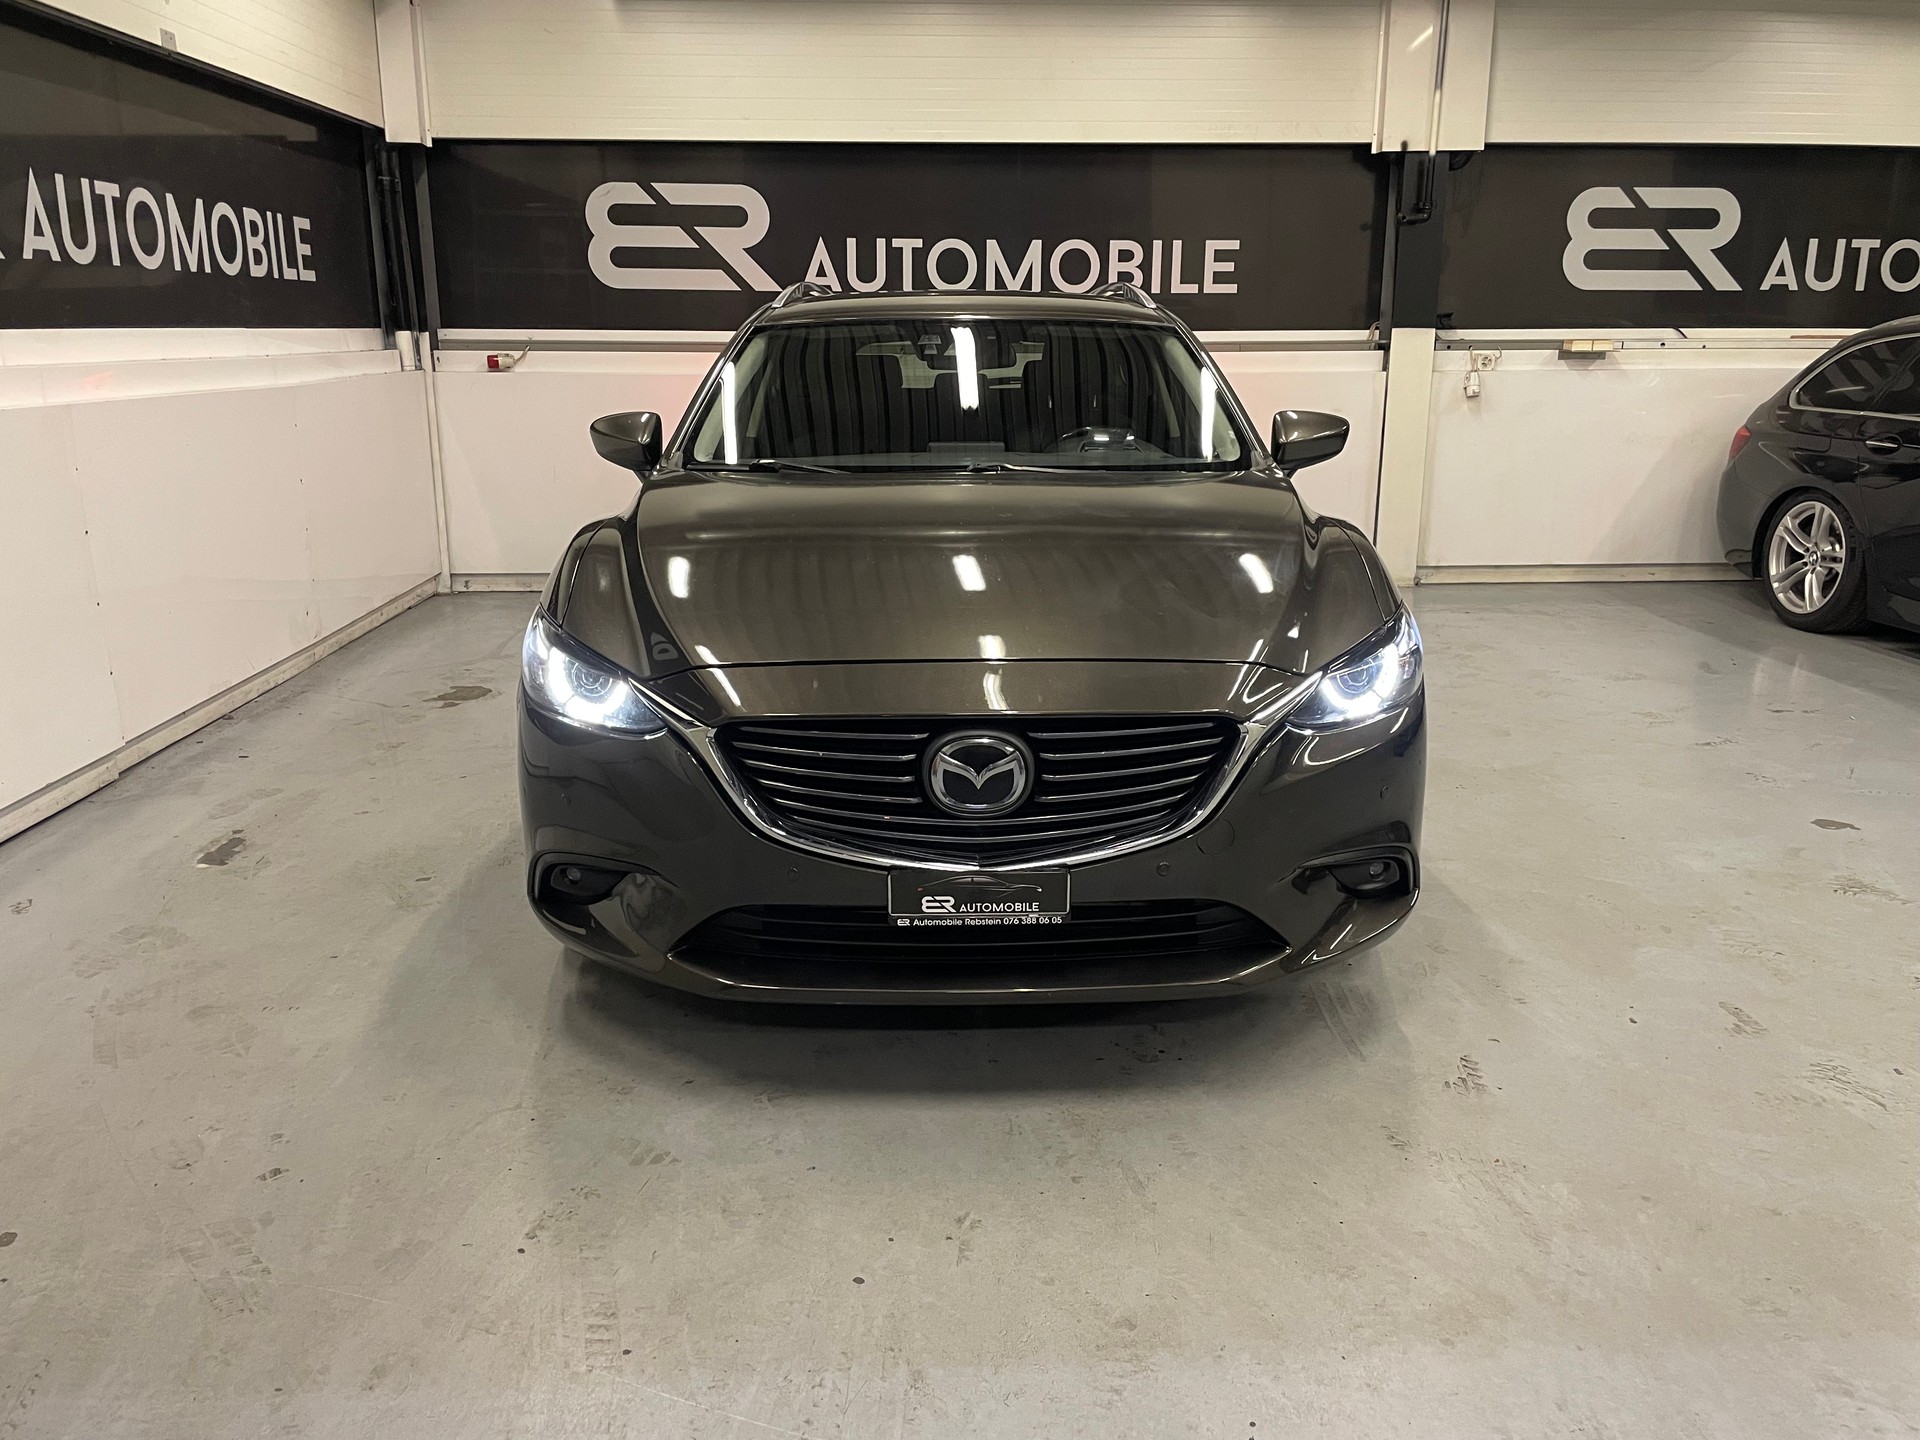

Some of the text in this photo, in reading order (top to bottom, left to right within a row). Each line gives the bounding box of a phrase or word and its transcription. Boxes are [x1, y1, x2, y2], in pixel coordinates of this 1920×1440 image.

[23, 166, 317, 282] AUTOMOBILE
[804, 235, 1241, 294] AUTOMOBILE
[1759, 236, 1920, 292] AUTO
[912, 918, 963, 926] Automobile
[964, 918, 1002, 926] Rebstein
[1003, 917, 1020, 925] 076
[1021, 916, 1037, 925] 388
[1038, 916, 1050, 924] 06
[1051, 916, 1063, 924] 05
[959, 902, 1040, 912] AUTOMOBILE
